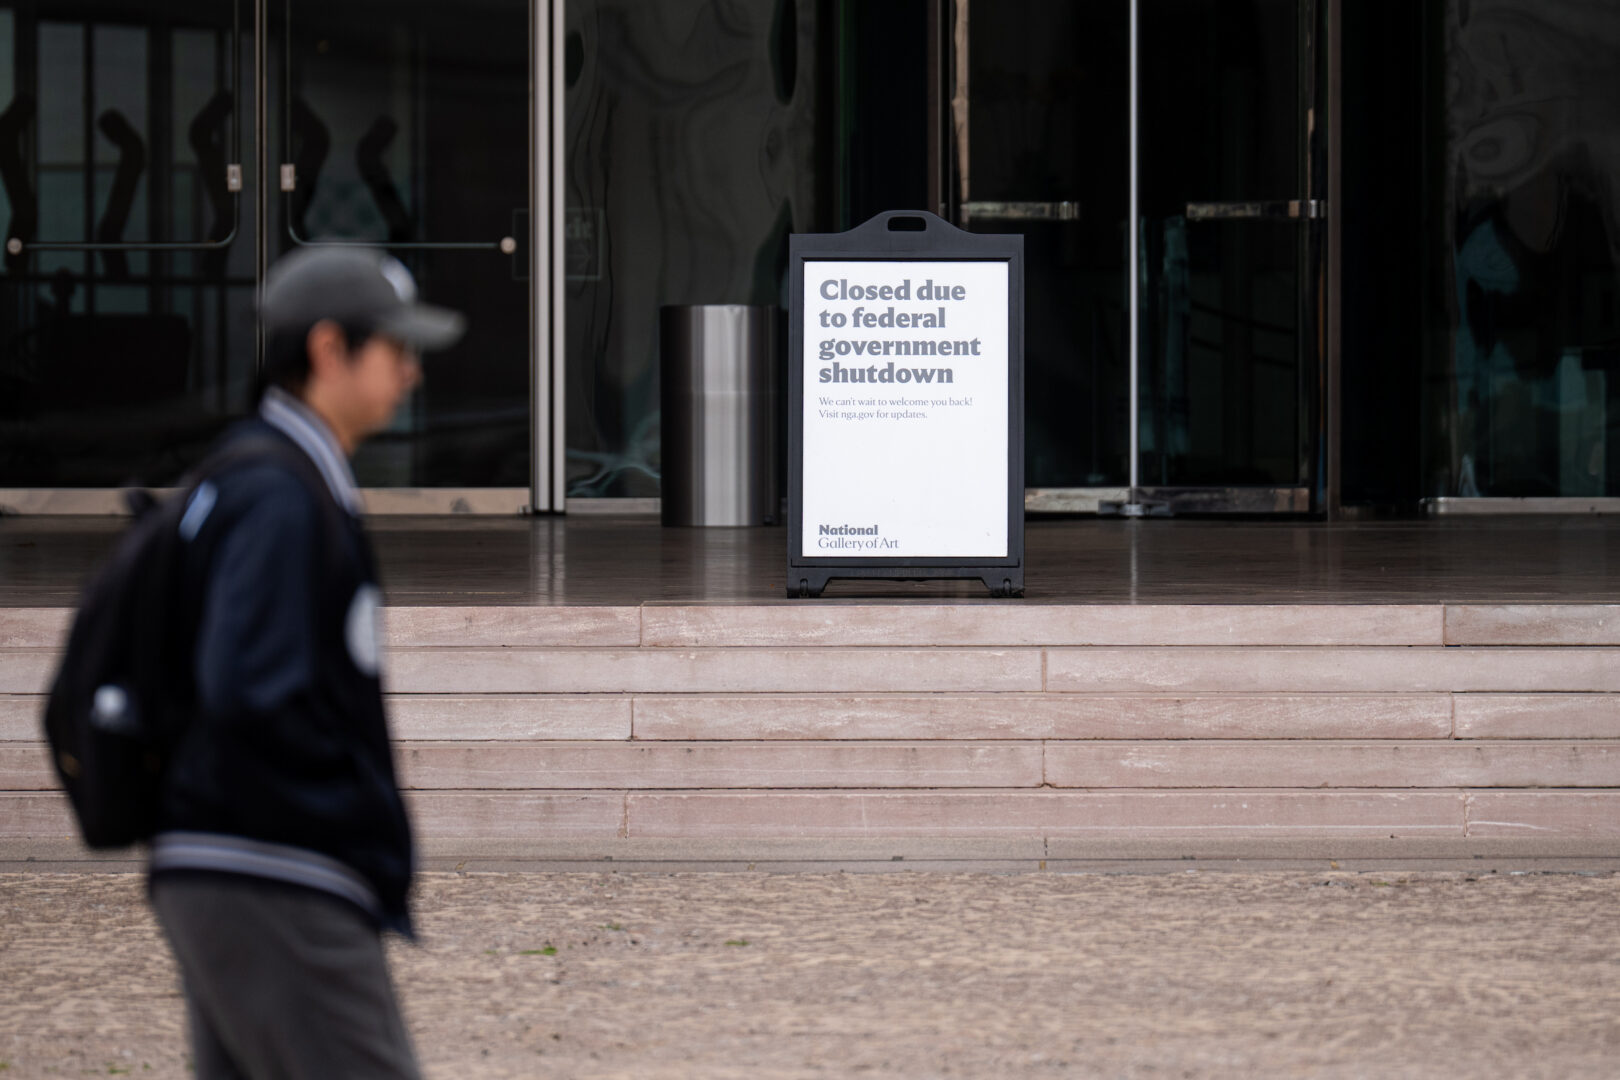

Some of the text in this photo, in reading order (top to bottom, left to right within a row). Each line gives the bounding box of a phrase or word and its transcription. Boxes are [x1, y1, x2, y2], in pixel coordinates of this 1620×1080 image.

[820, 279, 966, 300] Closed due
[819, 307, 946, 328] to federal
[819, 337, 981, 360] government
[819, 362, 953, 383] shutdown
[819, 396, 834, 406] We
[836, 396, 855, 406] can't
[858, 396, 875, 406] wait
[889, 396, 928, 406] welcome
[931, 399, 947, 409] you
[949, 396, 972, 407] back!
[819, 409, 927, 421] Visit nga.gov for updates.
[819, 524, 878, 535] National
[818, 537, 899, 551] Gallery of Art
